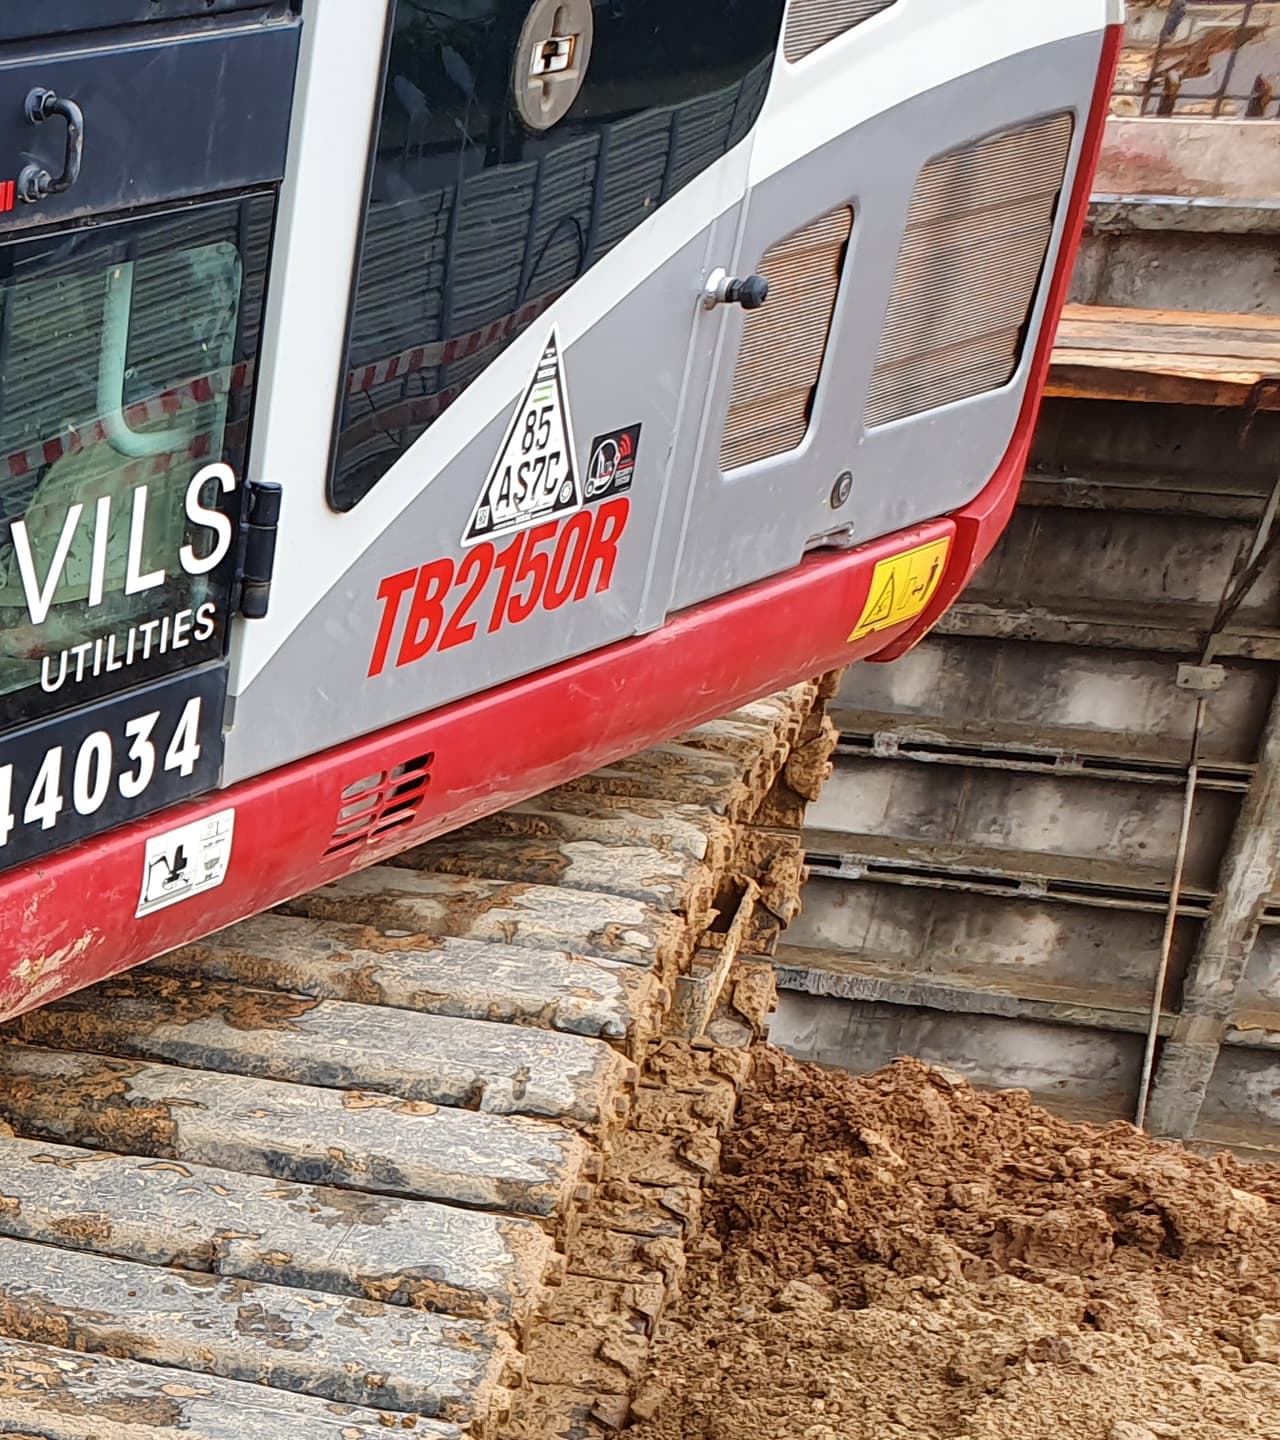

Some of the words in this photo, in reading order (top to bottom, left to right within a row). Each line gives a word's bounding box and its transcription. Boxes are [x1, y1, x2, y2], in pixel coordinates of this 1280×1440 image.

[521, 403, 555, 456] 85
[495, 451, 561, 512] AS7C
[366, 496, 631, 679] TB2150R
[40, 602, 216, 693] UTILITIES
